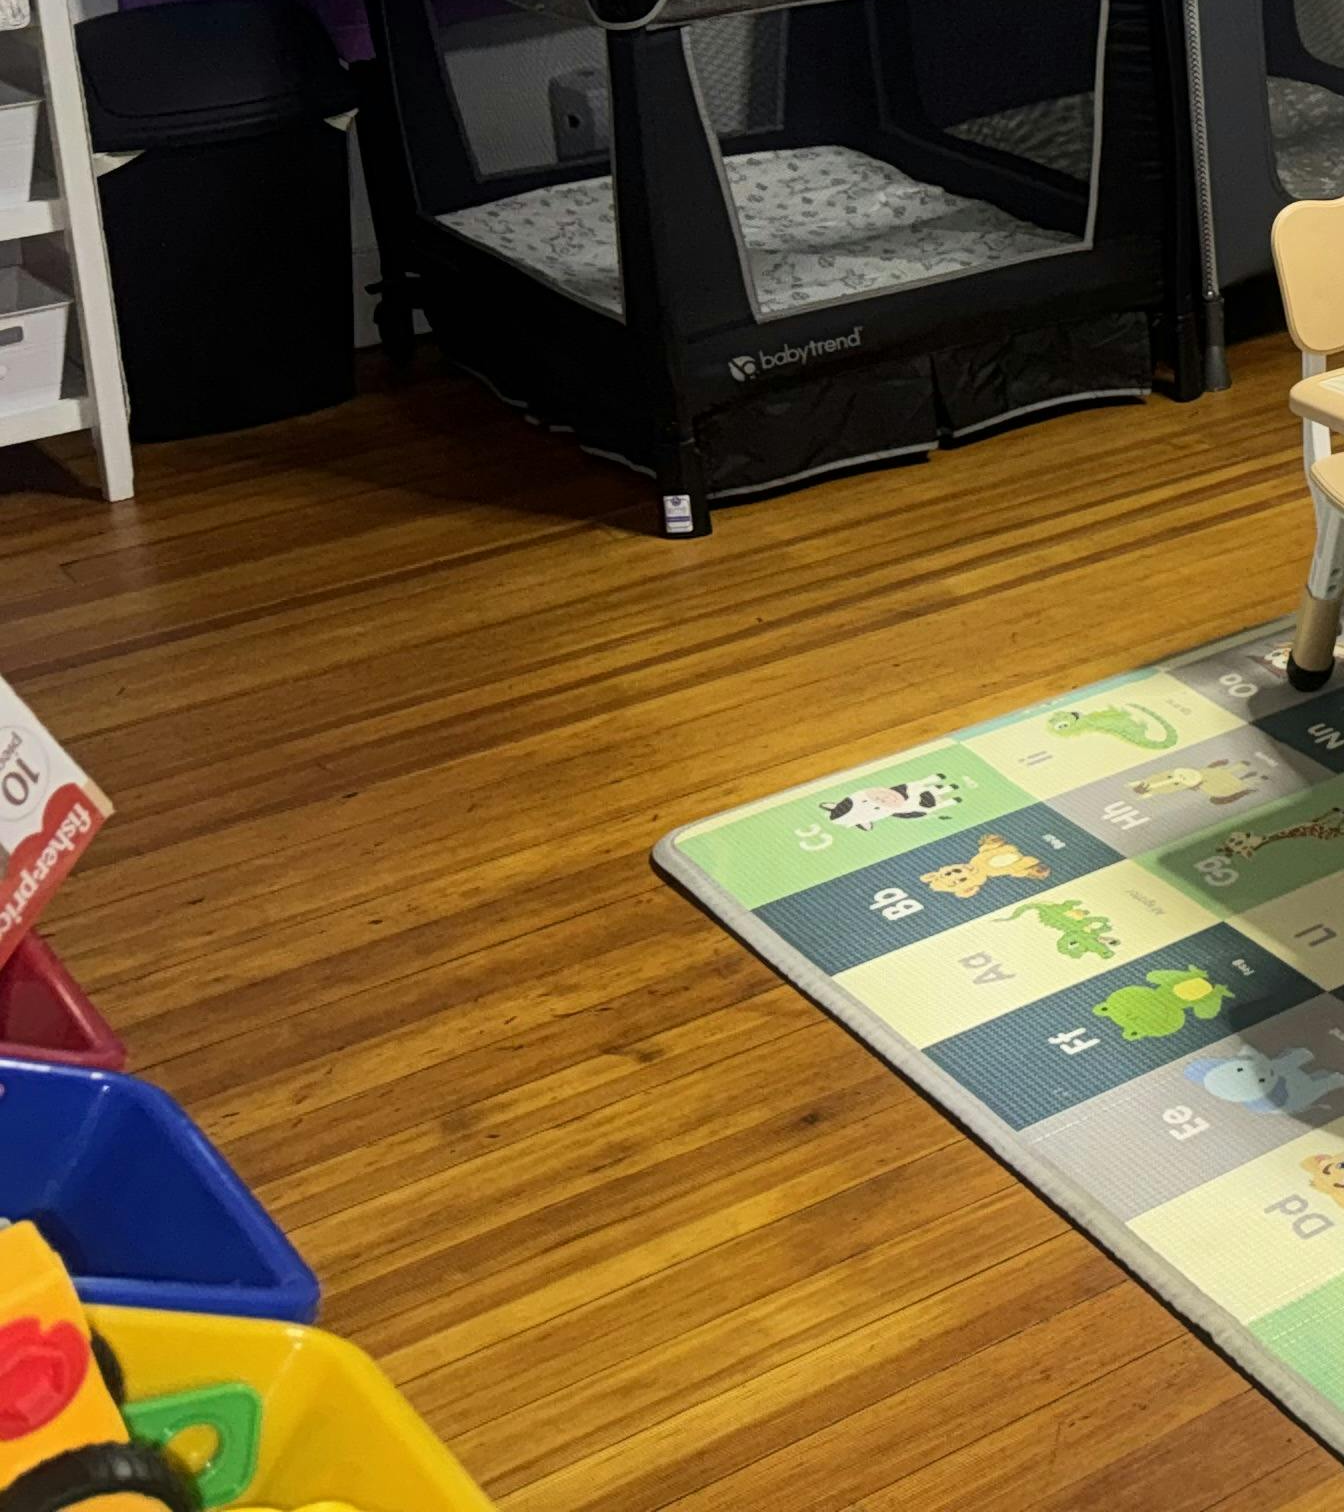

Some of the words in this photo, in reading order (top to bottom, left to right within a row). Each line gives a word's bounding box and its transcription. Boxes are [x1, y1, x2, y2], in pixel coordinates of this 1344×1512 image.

[759, 327, 862, 368] babytrend
[1, 757, 41, 806] 10
[1100, 800, 1152, 830] Hh
[794, 821, 834, 852] Cc
[0, 801, 92, 936] fisher-pric
[1194, 854, 1239, 886] Gg
[869, 887, 924, 922] Bb
[957, 950, 1018, 986] Aa
[1048, 1025, 1102, 1055] Ff
[1162, 1104, 1210, 1141] Ee
[1263, 1193, 1335, 1241] Dd
